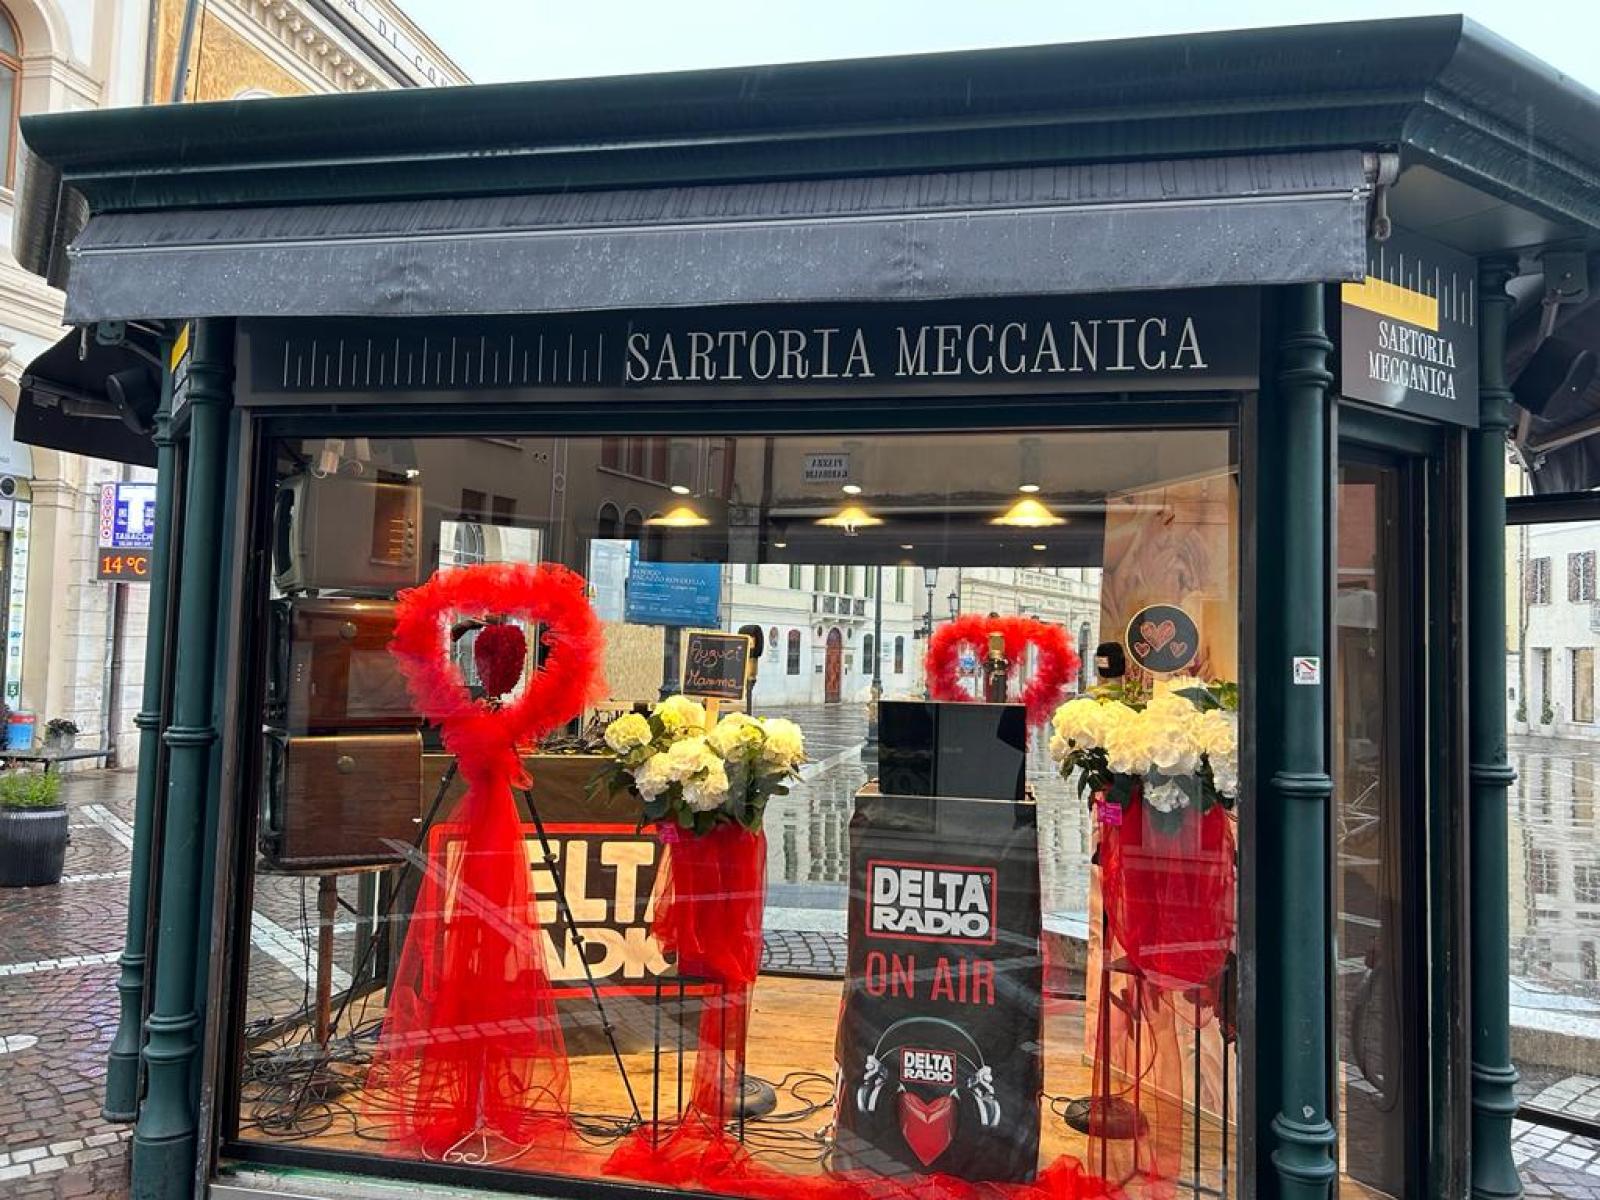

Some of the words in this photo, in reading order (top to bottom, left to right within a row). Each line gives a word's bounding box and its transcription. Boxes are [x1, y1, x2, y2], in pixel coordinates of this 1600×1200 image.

[625, 327, 876, 381] SARTORIA
[894, 317, 1209, 376] MECCANICA
[1378, 320, 1456, 368] SARTORIA
[1368, 350, 1456, 400] MECCANICA
[102, 556, 122, 575] 14
[687, 669, 737, 688] Mamma
[873, 866, 989, 912] DELTA
[872, 906, 990, 937] RADIO
[864, 950, 915, 999] ON
[931, 956, 996, 1006] AIR
[904, 1051, 953, 1073] DELTA
[904, 1068, 953, 1082] RADIO
